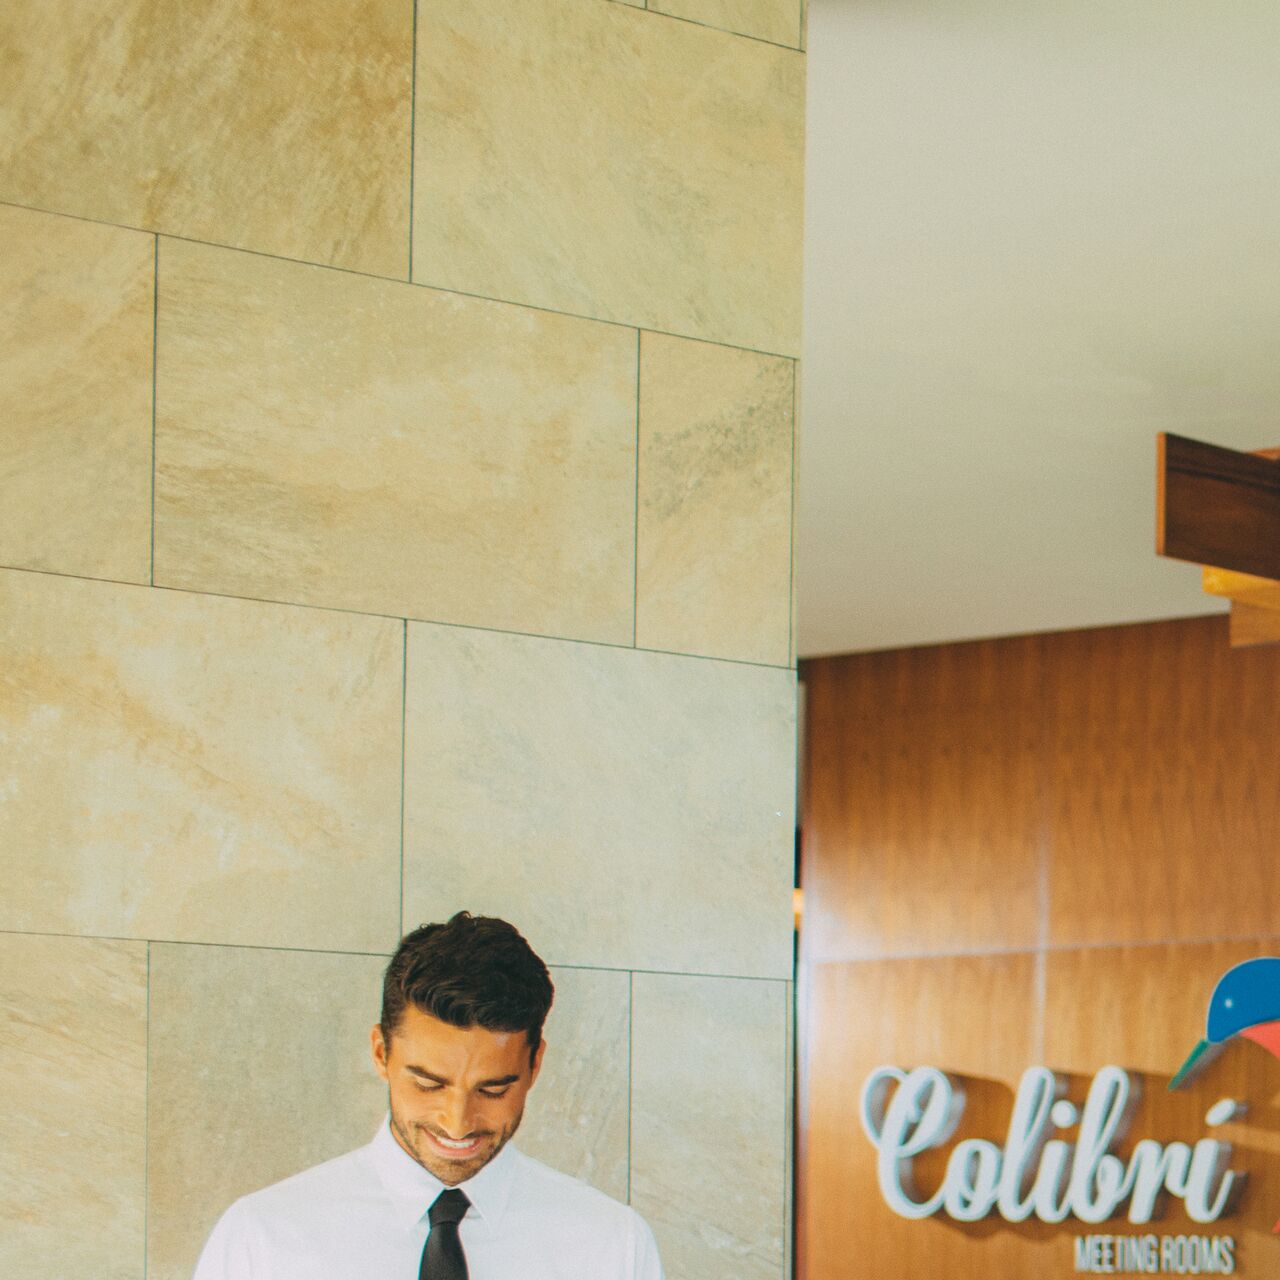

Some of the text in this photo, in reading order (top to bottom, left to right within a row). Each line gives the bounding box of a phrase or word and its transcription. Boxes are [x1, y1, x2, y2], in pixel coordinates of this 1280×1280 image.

[861, 1065, 1236, 1223] Colibrí
[1075, 1235, 1235, 1275] MEETING ROOMS
